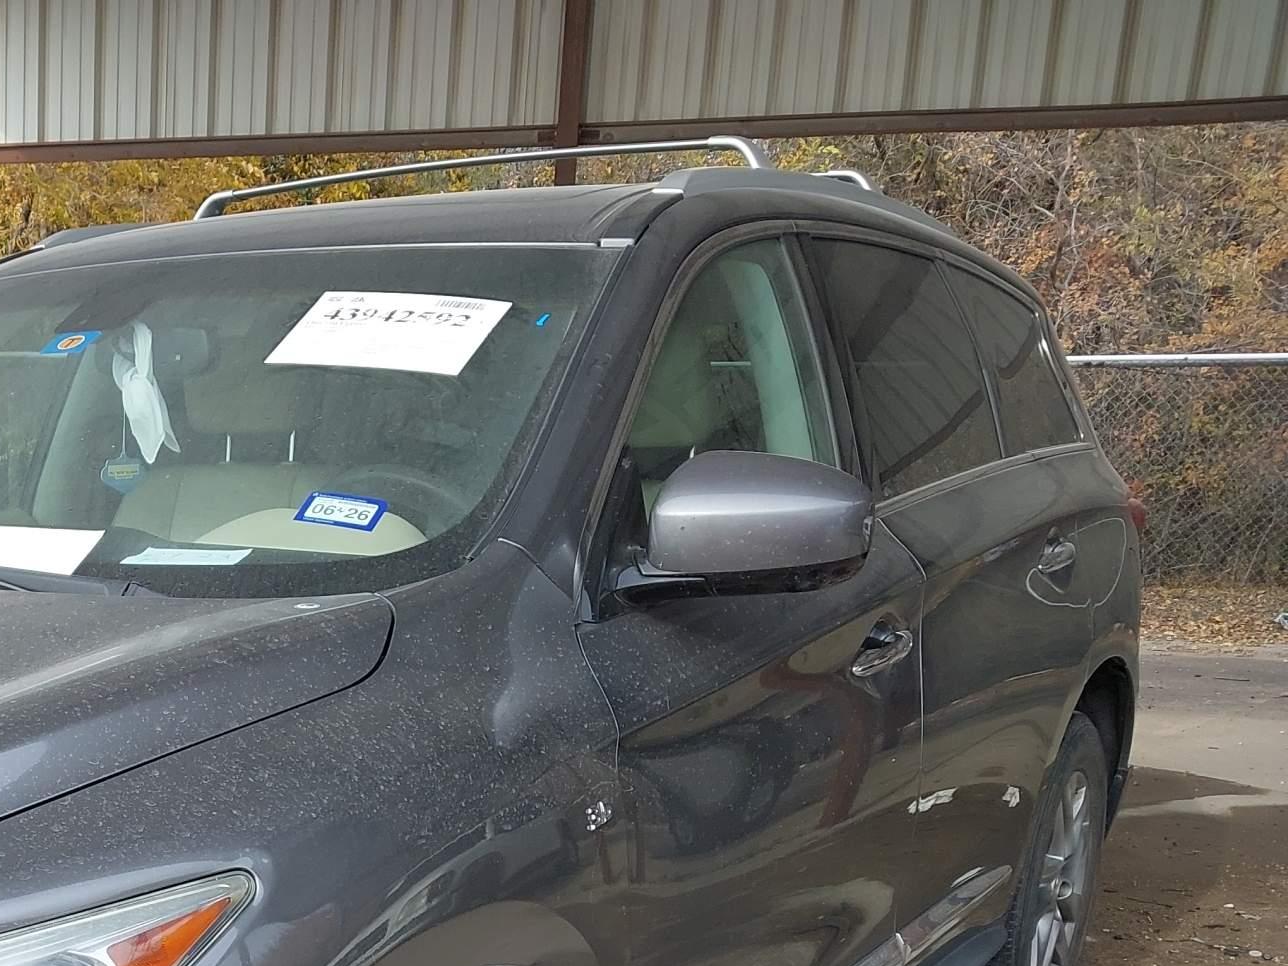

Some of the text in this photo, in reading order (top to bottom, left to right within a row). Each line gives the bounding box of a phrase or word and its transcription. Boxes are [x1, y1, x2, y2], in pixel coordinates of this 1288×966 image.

[323, 307, 472, 327] 43942592
[311, 503, 337, 516] 06
[344, 507, 371, 521] 26
